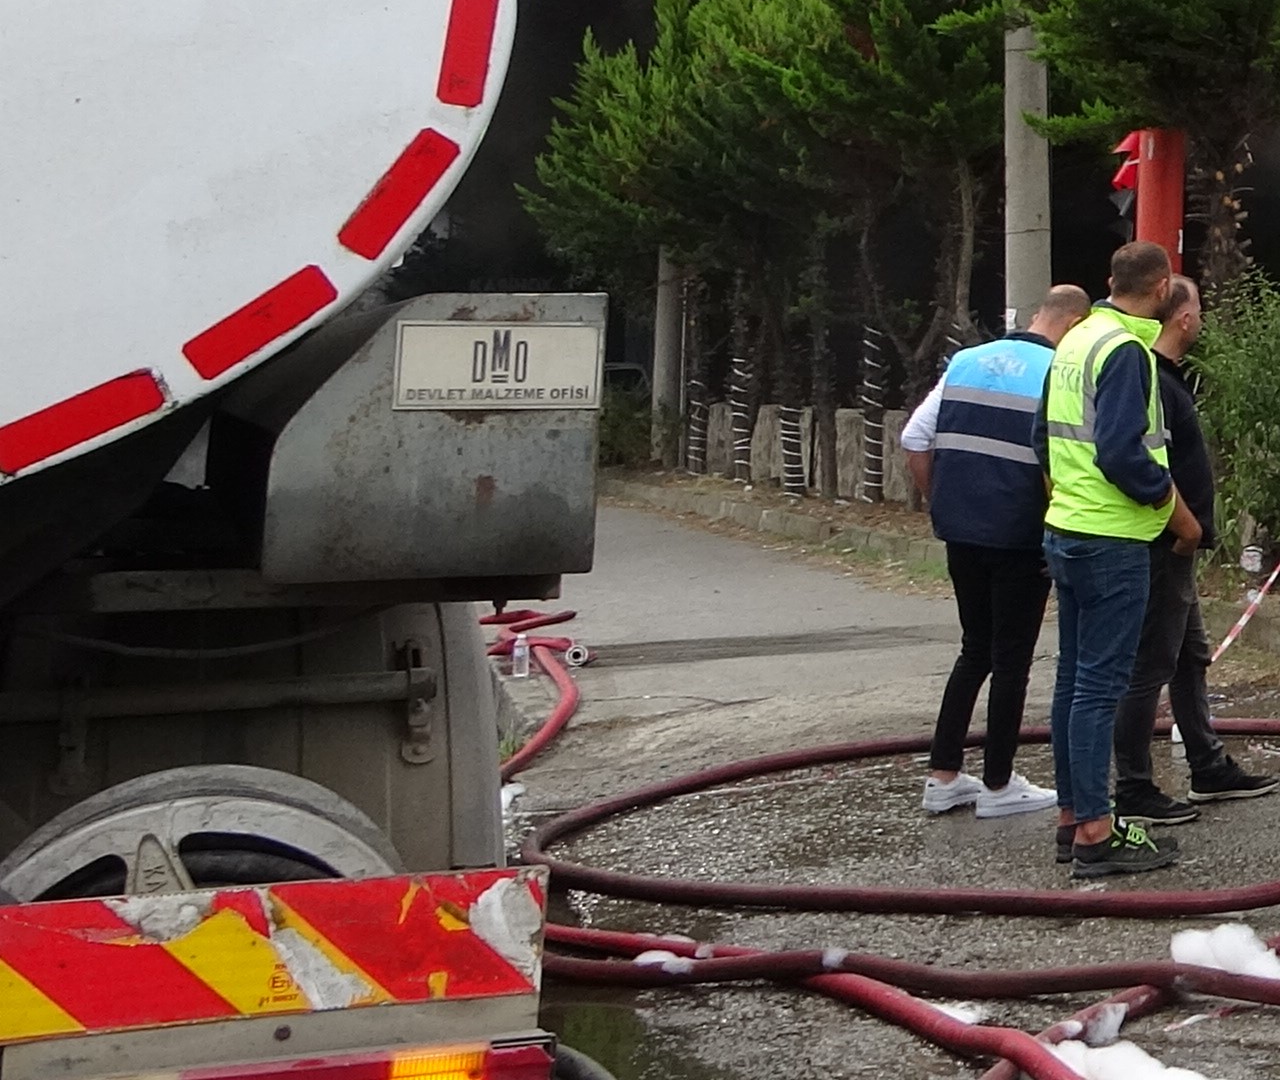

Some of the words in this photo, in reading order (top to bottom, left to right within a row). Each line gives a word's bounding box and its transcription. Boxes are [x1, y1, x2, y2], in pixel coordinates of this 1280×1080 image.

[472, 329, 528, 383] DMO
[406, 388, 466, 400] DEVLET
[471, 388, 545, 400] MALZEME
[550, 385, 589, 400] OFİSİ
